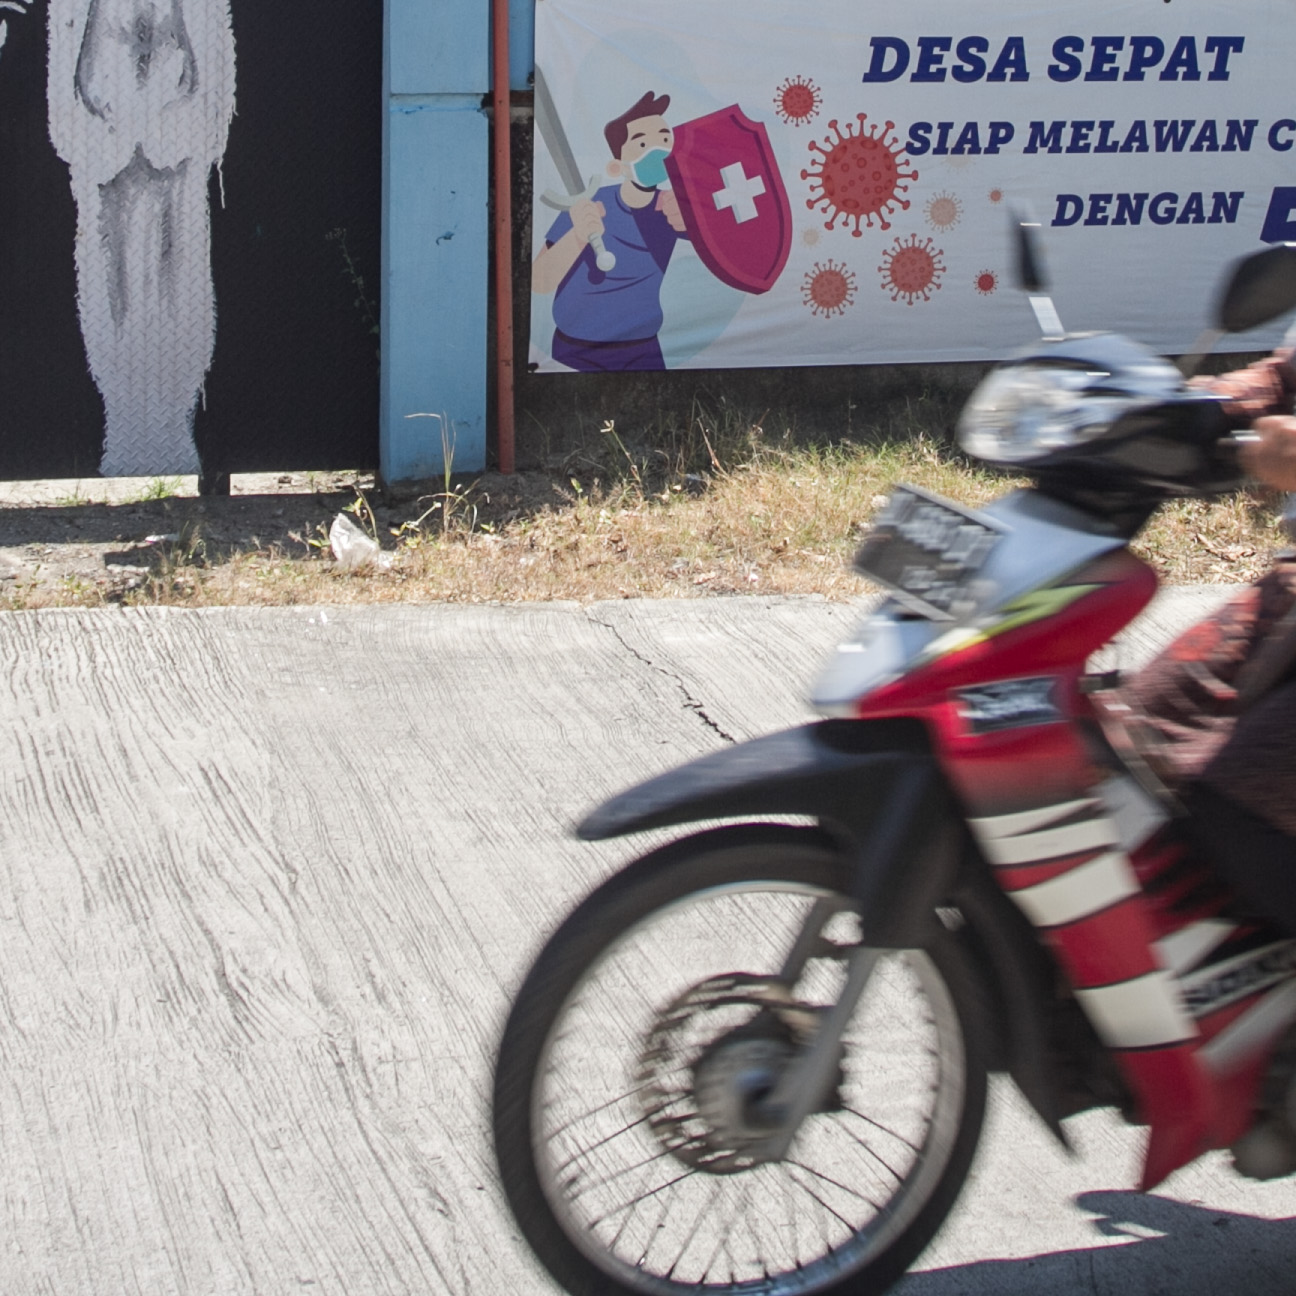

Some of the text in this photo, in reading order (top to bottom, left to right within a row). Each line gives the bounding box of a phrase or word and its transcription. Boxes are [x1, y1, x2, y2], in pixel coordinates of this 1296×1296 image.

[862, 35, 1246, 83] DESA SEPAT
[905, 120, 1015, 156] SIAP
[1023, 119, 1259, 154] MELAWAN
[1051, 191, 1245, 227] DENGAN
